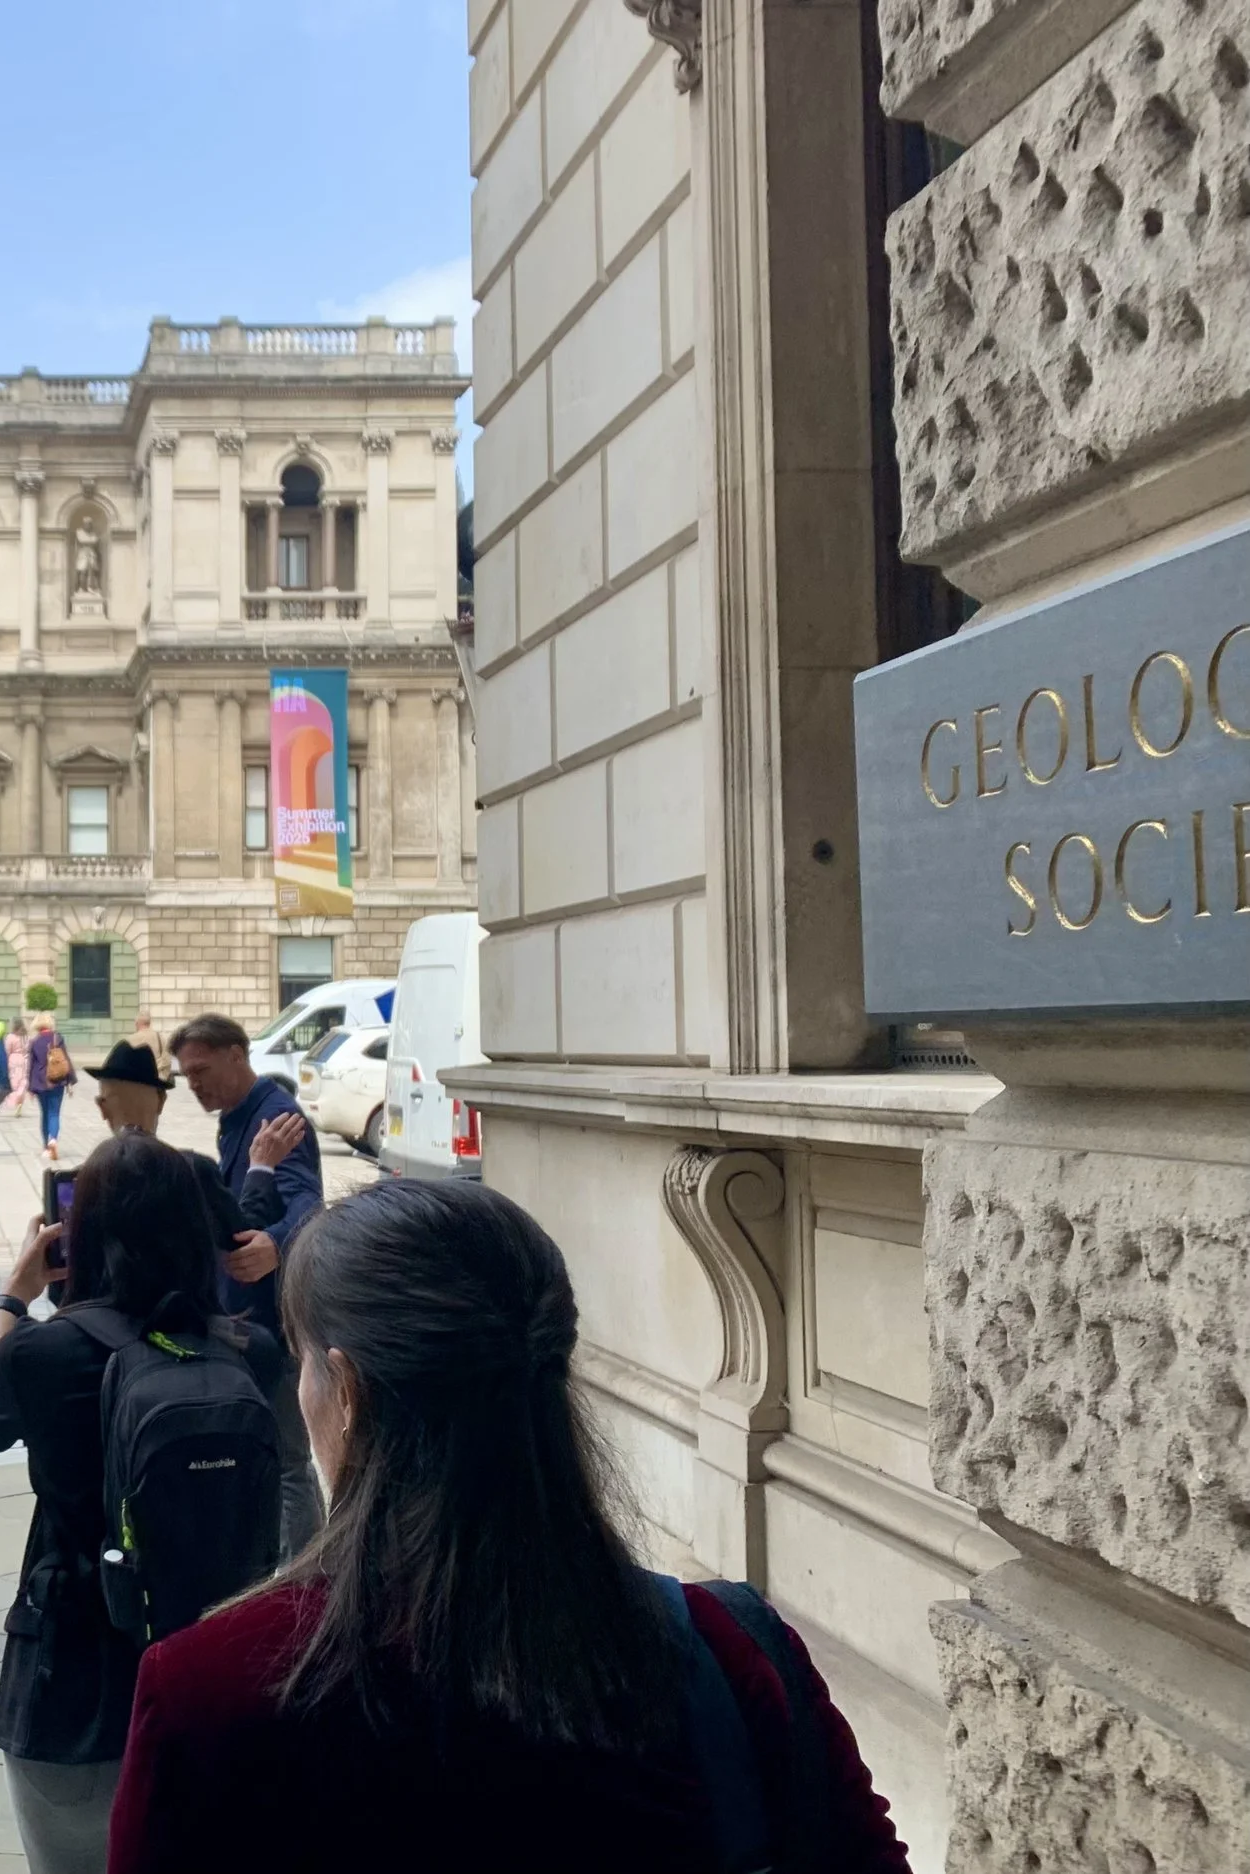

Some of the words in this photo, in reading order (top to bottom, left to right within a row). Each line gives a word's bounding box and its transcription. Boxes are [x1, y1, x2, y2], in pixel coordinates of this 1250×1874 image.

[274, 676, 307, 713] RA
[277, 806, 336, 820] Summer
[277, 819, 346, 833] Exhibition
[277, 831, 311, 845] 2025
